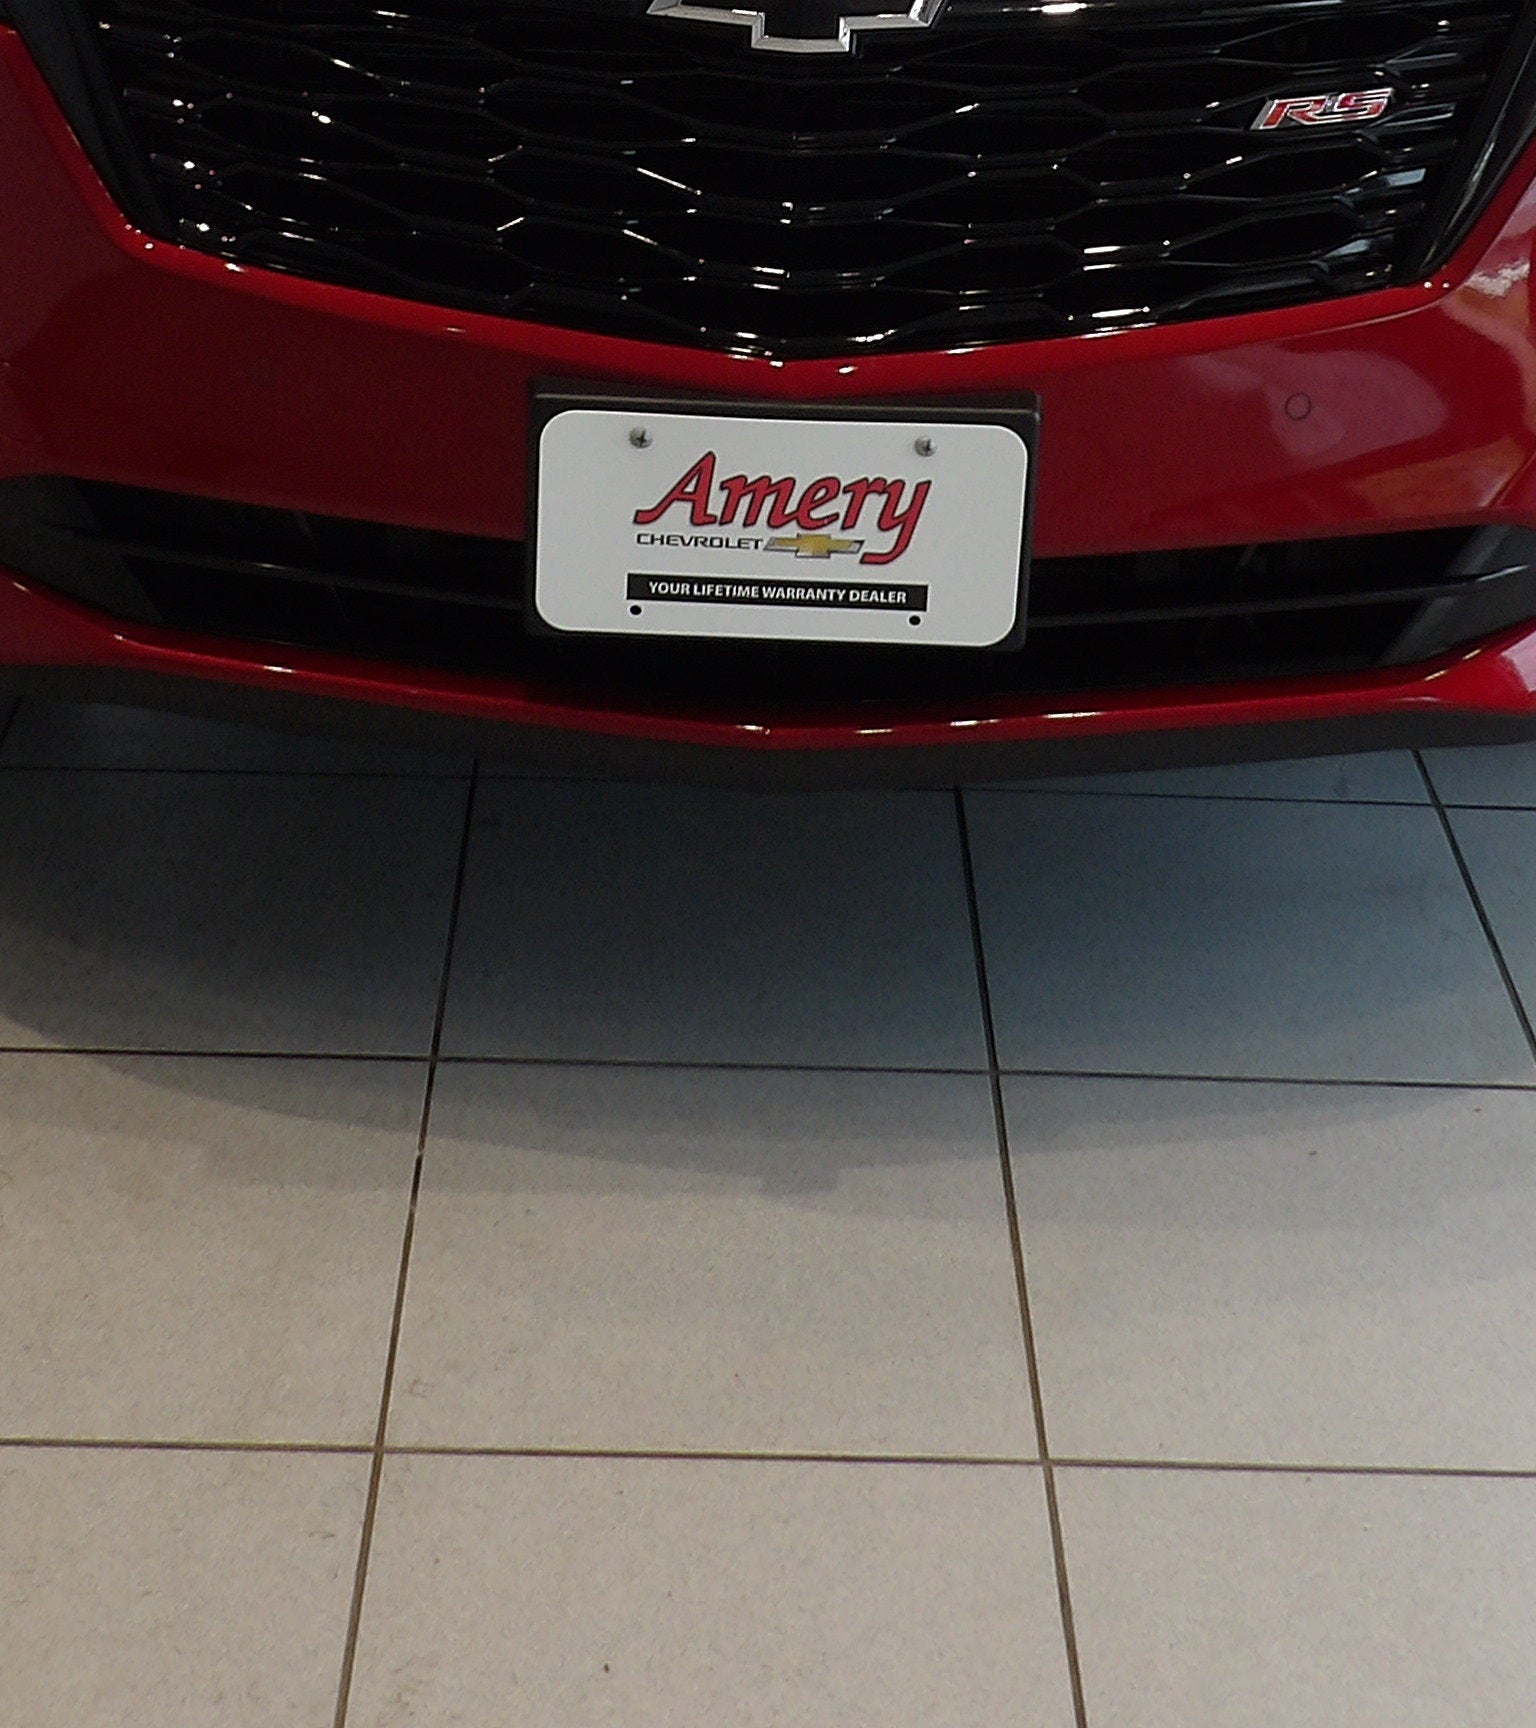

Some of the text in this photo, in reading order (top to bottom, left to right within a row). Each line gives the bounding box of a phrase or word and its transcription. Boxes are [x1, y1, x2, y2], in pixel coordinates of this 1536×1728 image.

[1250, 87, 1395, 131] RS
[632, 450, 932, 565] Amery
[636, 532, 764, 551] CHEVROLET
[649, 580, 907, 604] YOUR LIFETIME WARRANTY DEALER
